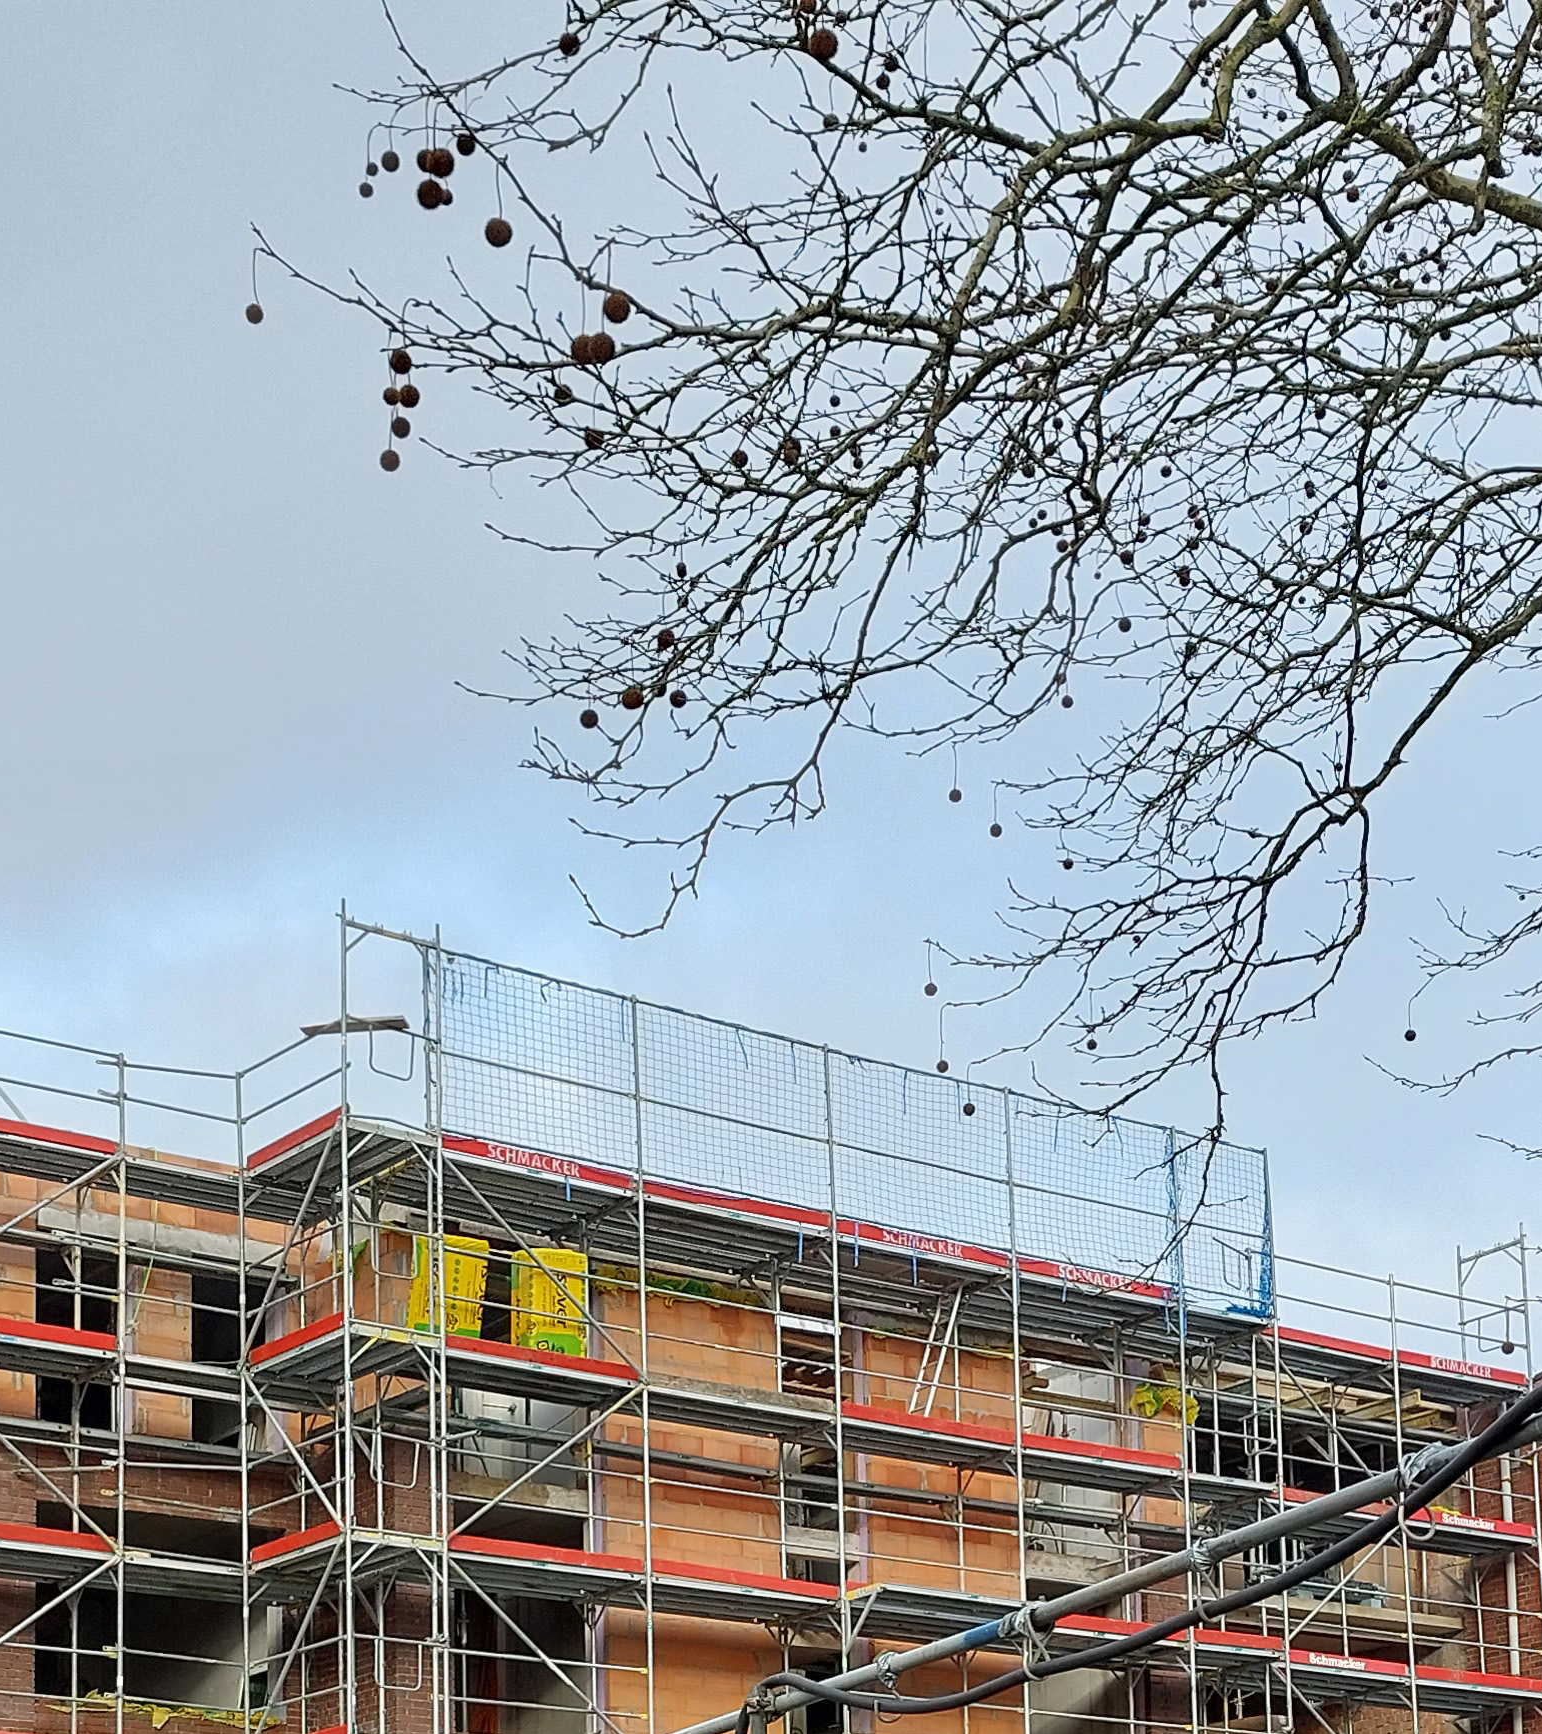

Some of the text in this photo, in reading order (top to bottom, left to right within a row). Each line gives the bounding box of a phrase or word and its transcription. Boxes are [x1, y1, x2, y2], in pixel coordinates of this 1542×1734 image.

[487, 1144, 580, 1178] SCHMACKER
[882, 1229, 963, 1258] SCHMACKER
[1430, 1356, 1491, 1378] SCHMACKER
